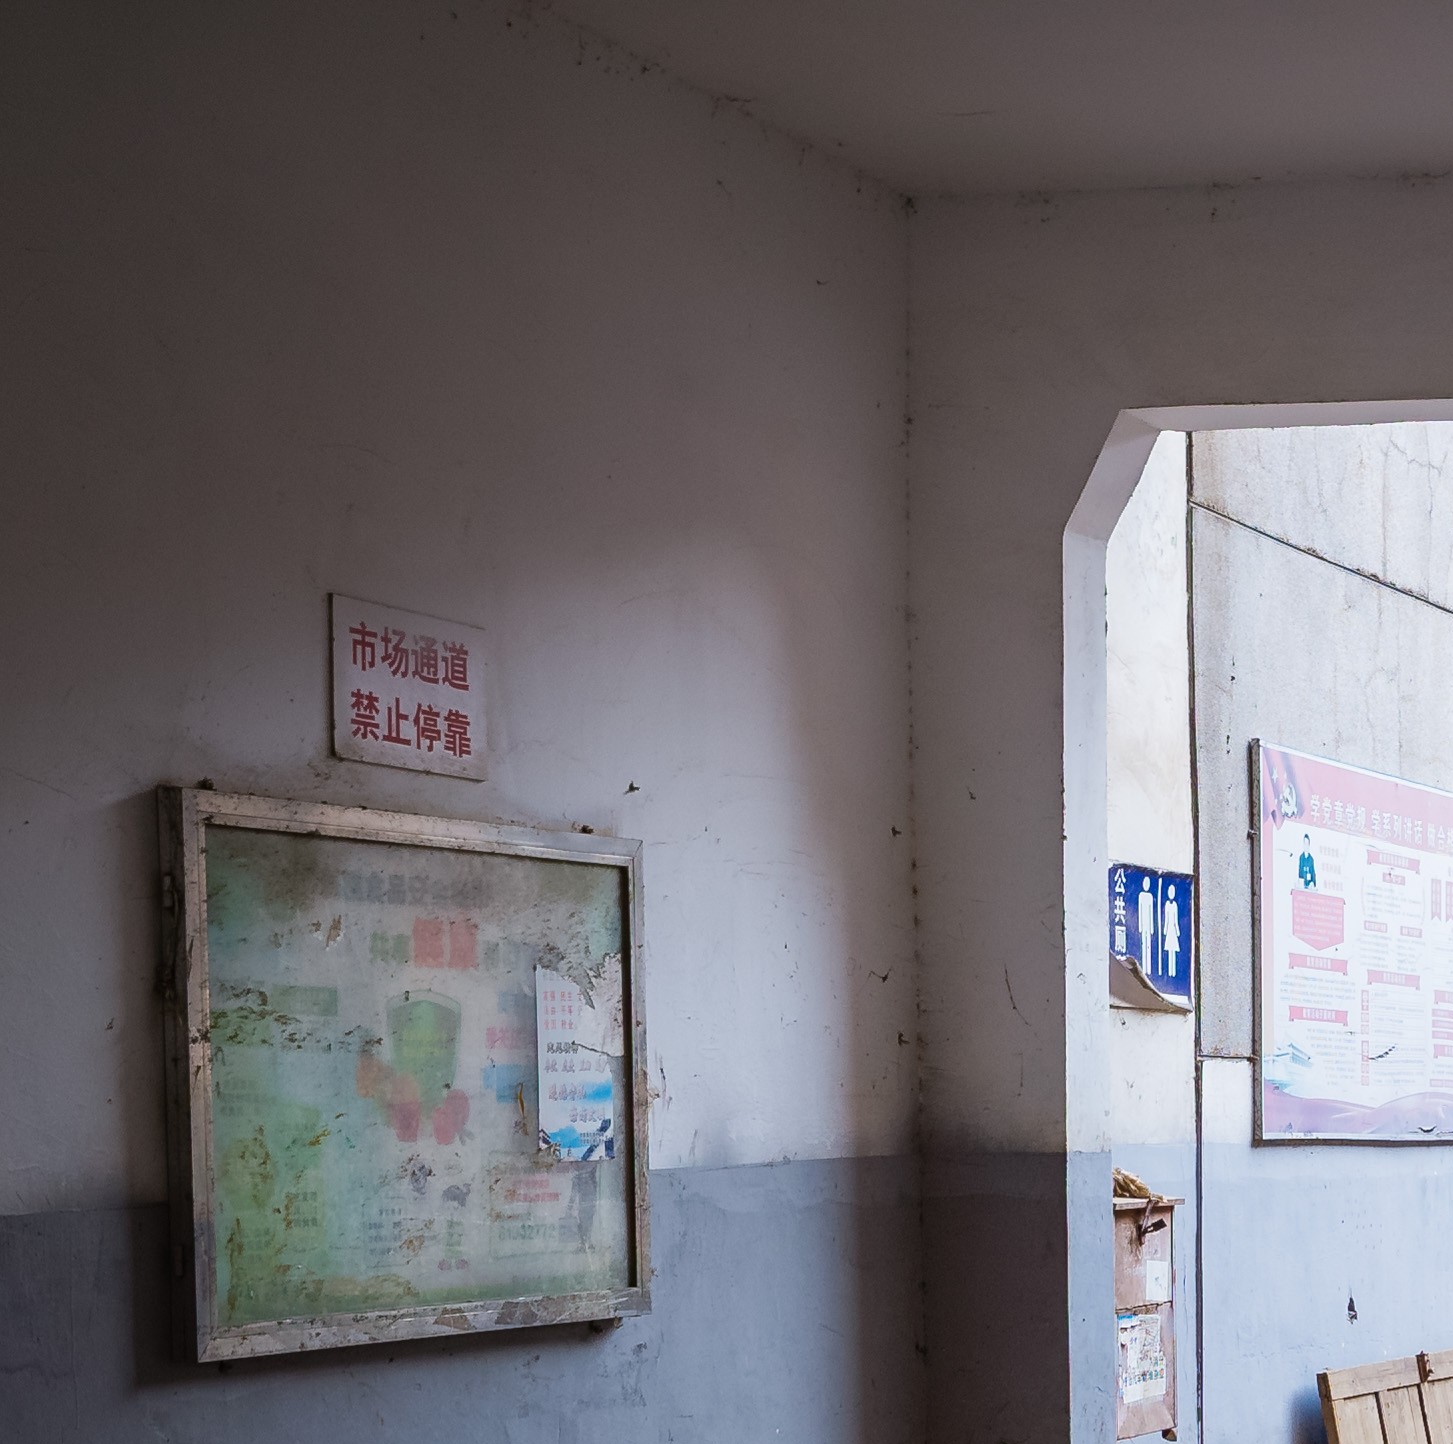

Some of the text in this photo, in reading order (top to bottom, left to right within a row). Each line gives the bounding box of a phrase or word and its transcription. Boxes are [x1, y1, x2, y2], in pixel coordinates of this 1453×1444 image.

[348, 621, 470, 693] 市场通道
[350, 687, 473, 760] 禁止停靠
[1371, 809, 1423, 847] 学系列讲话
